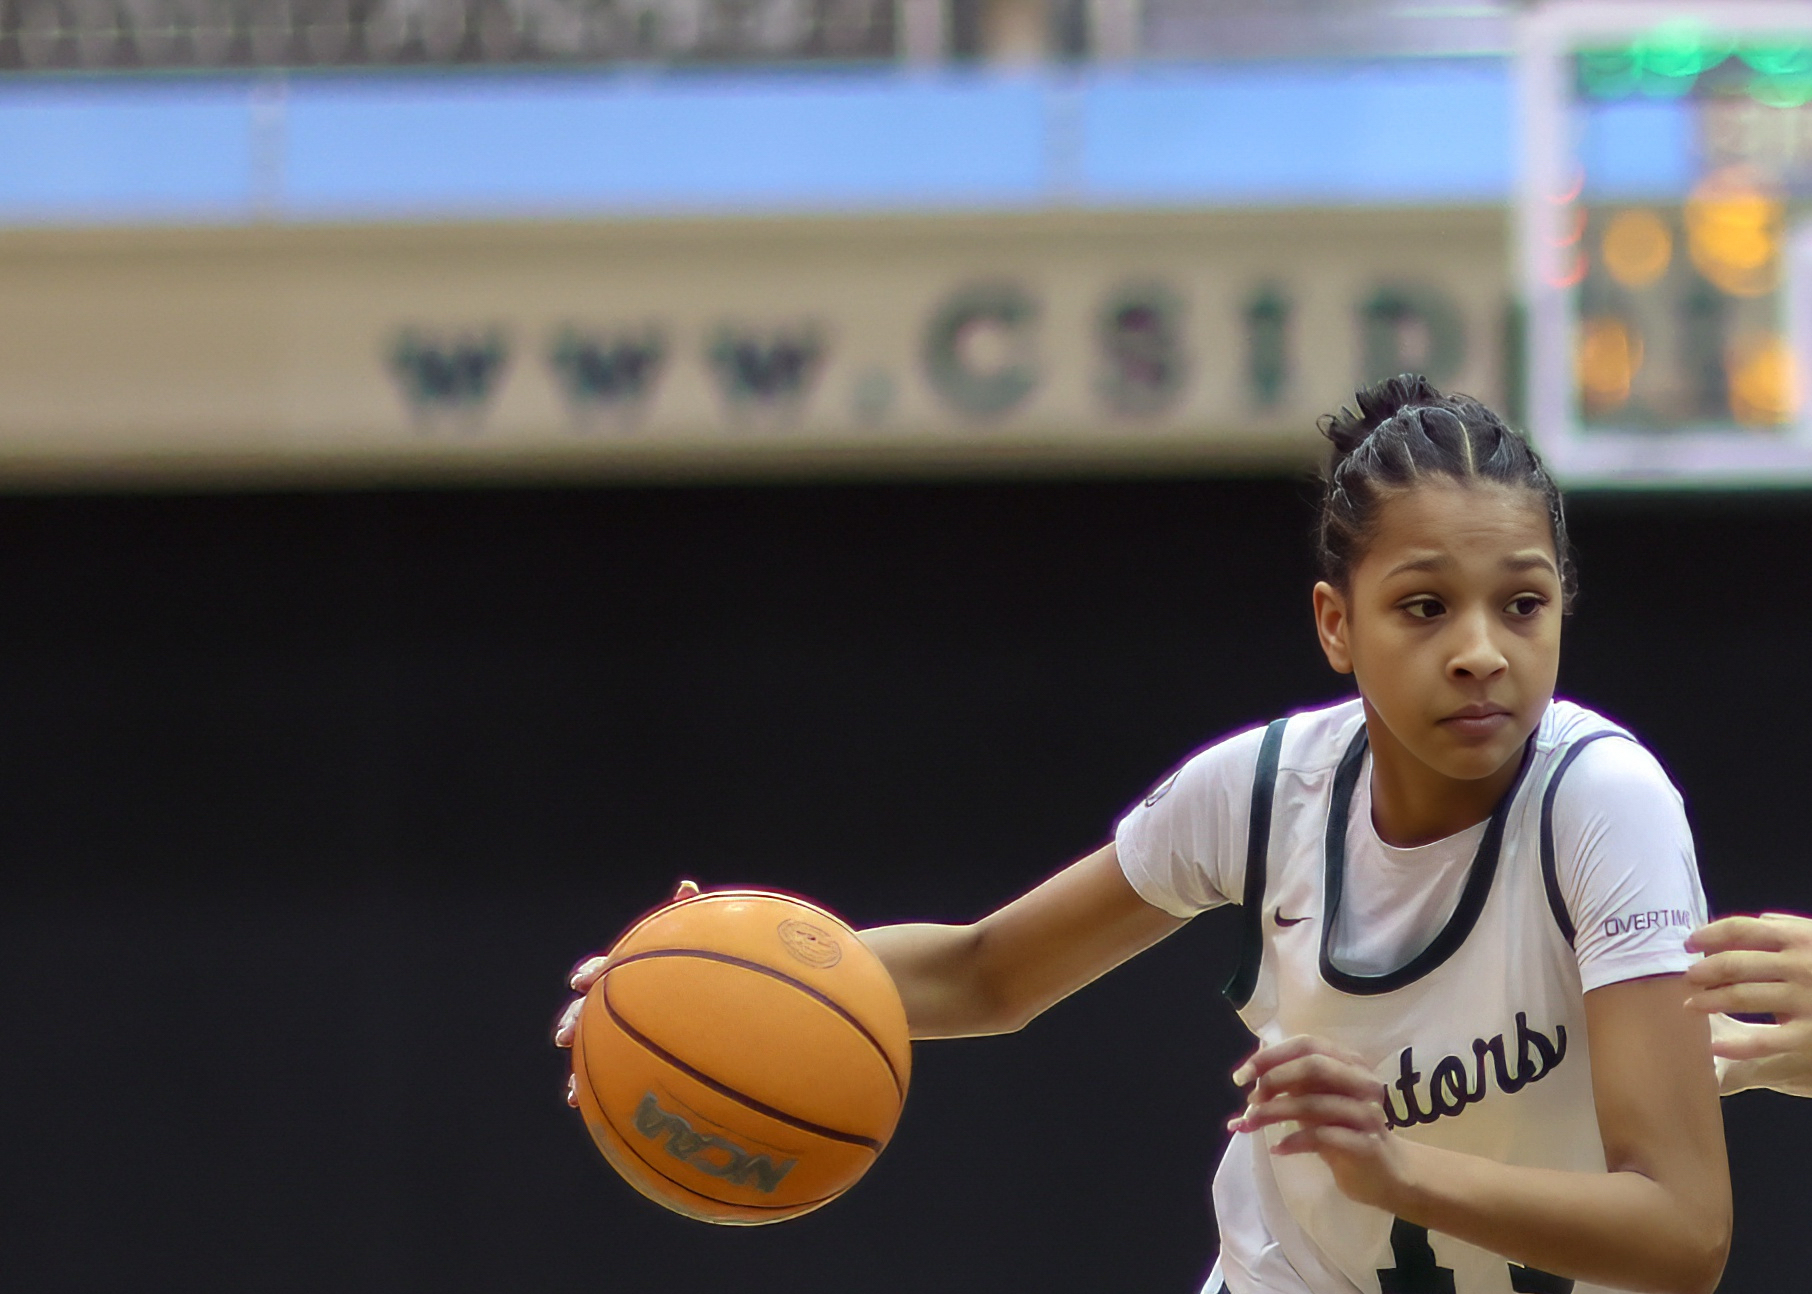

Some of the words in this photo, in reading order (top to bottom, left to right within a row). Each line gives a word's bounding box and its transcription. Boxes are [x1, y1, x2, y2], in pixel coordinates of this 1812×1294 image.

[1604, 909, 1691, 937] OVERTIM
[1383, 1011, 1567, 1131] tors
[631, 1090, 799, 1193] NCAA
